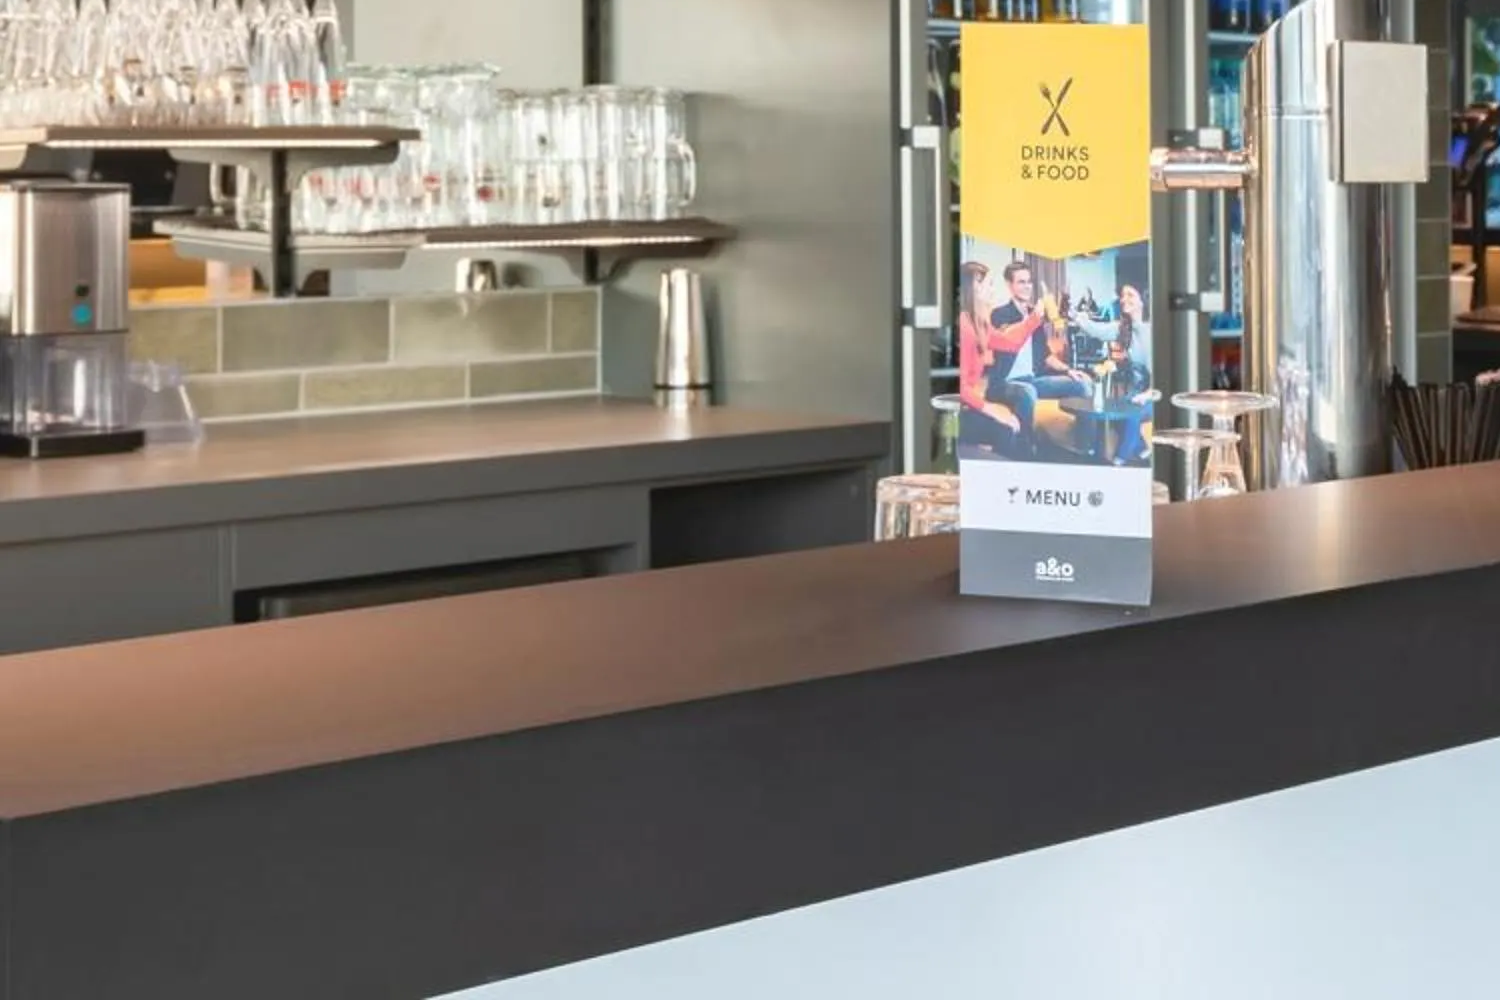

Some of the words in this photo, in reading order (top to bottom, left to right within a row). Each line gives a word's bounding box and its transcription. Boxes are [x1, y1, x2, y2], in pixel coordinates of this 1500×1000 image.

[1021, 145, 1090, 161] DRINKS
[1021, 164, 1034, 180] &
[1037, 164, 1090, 181] FOOD
[1025, 488, 1082, 507] MENU
[1035, 557, 1075, 577] a&o
